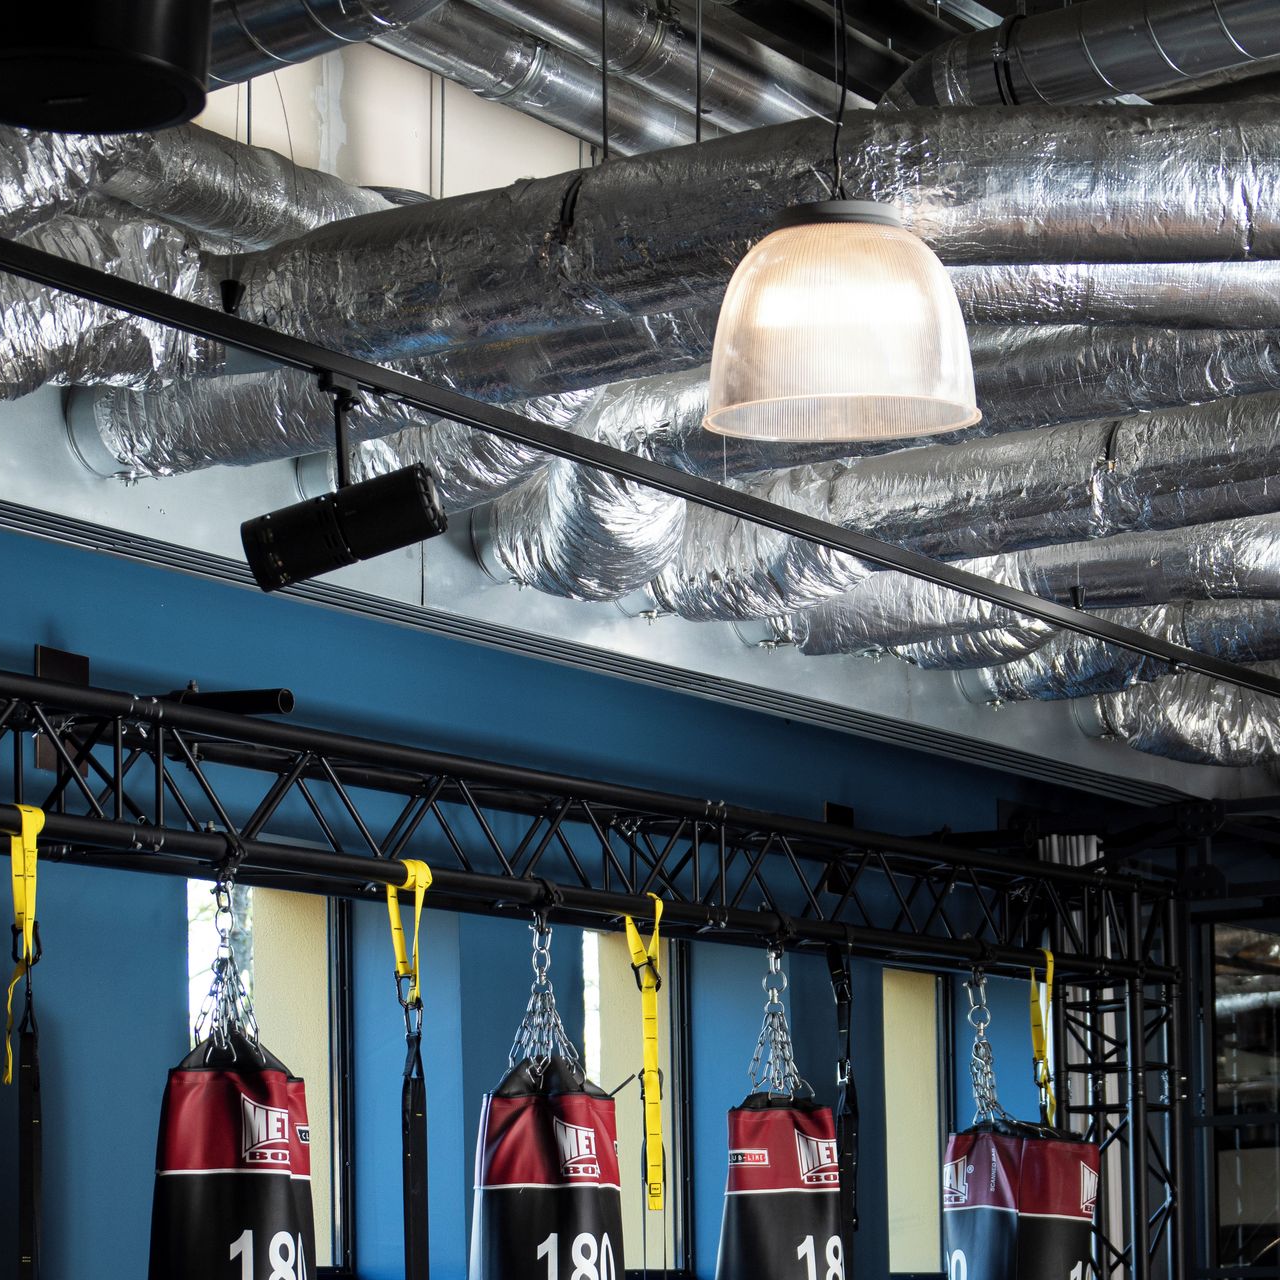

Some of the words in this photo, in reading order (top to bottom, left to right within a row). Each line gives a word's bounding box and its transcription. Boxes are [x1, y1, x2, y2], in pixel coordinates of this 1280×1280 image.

[249, 1151, 288, 1161] BO
[564, 1165, 598, 1175] BO
[807, 1174, 838, 1182] BO
